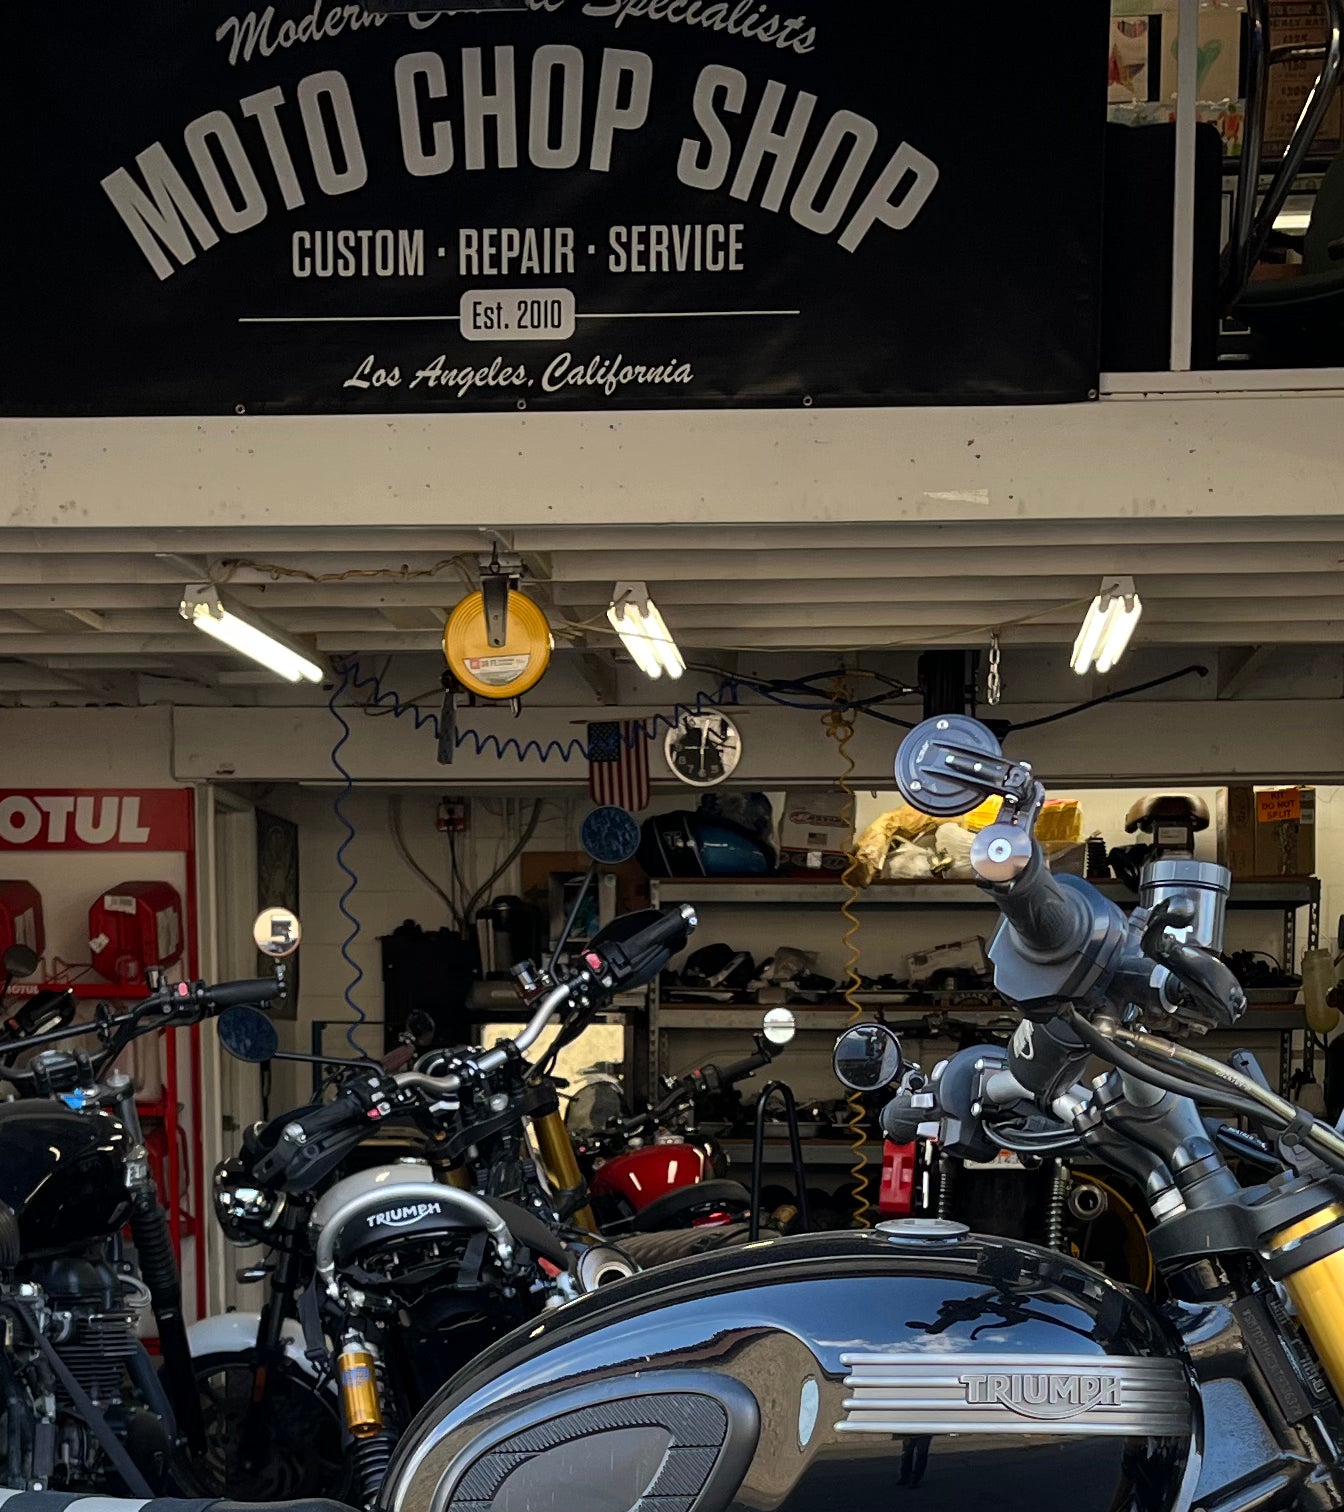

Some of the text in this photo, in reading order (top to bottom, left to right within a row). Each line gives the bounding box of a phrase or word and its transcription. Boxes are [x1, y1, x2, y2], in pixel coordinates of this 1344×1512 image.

[100, 44, 939, 282] MOTO CHOP SHOP
[292, 223, 744, 278] CUSTOM REPAIR SERVICE
[472, 299, 562, 330] Est. 2010
[343, 355, 402, 389] Los
[541, 352, 694, 396] California
[1261, 800, 1295, 810] DO NOT
[6, 984, 39, 994] MOTUL
[367, 1203, 441, 1227] TRIUMPH
[959, 1374, 1122, 1418] TRIUMPH
